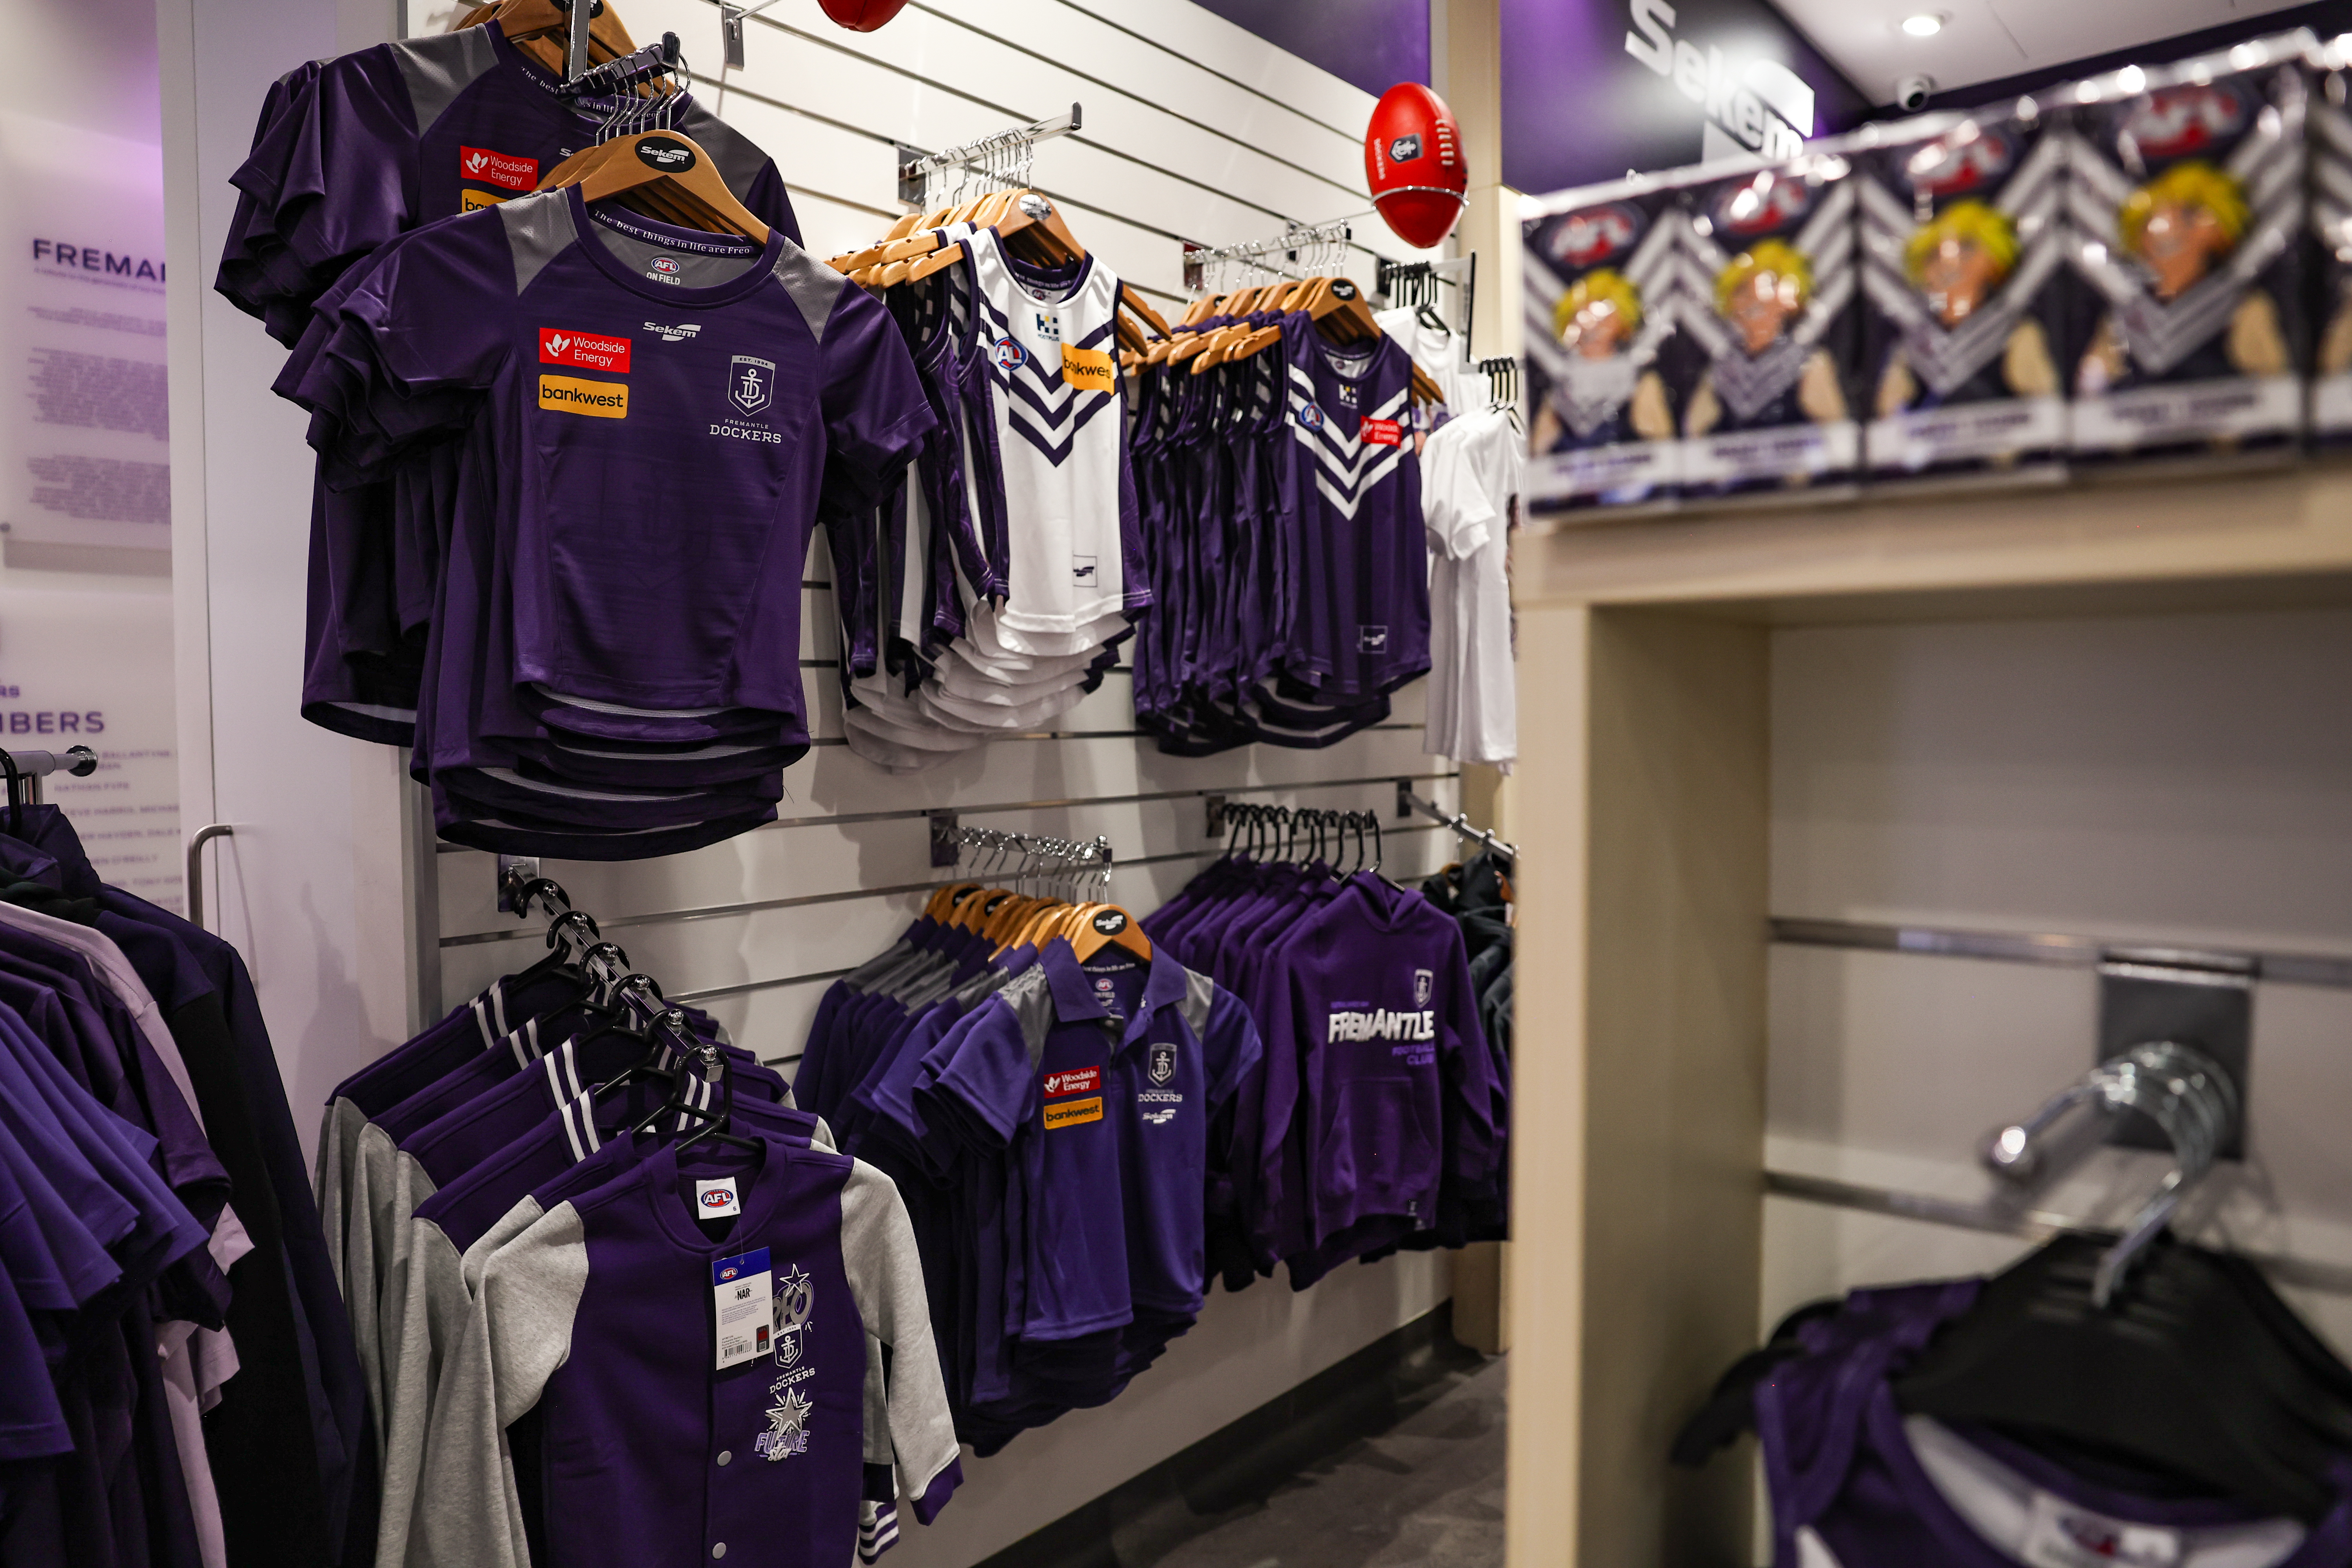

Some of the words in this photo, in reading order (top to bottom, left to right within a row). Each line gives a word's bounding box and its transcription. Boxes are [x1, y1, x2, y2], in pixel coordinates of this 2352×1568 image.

[521, 66, 536, 81] The
[539, 80, 559, 94] best
[1624, 0, 1808, 160] Sekem
[592, 102, 601, 110] in
[603, 104, 615, 113] lif
[640, 146, 688, 163] Sekem
[490, 155, 533, 172] Woodside
[492, 169, 523, 186] Energy
[595, 209, 613, 223] The
[617, 220, 639, 235] best
[642, 231, 675, 246] things
[677, 240, 687, 249] in
[690, 242, 706, 252] life
[33, 238, 165, 284] FREMA
[654, 260, 676, 271] AFL
[646, 272, 658, 281] ON
[659, 274, 681, 285] FIELD
[643, 321, 700, 339] Sekem
[573, 336, 625, 354] Woodside
[574, 350, 613, 367] Energy
[542, 384, 624, 408] bankwest
[725, 419, 769, 429] FREMANTLE
[710, 424, 782, 444] DOCKERS
[0, 711, 104, 734] BERS
[1328, 1008, 1435, 1044] FREMANTLE
[1061, 1069, 1097, 1083] Woodside
[1063, 1080, 1090, 1091] Energy
[1138, 1093, 1183, 1102] DOCKERS
[1046, 1105, 1100, 1122] bankwest
[704, 1192, 731, 1204] AFL
[722, 1269, 736, 1278] AFL
[737, 1288, 750, 1301] NAR
[769, 1367, 816, 1394] DOCKERS
[776, 1366, 805, 1381] FREMANTLE
[768, 1442, 792, 1461] star
